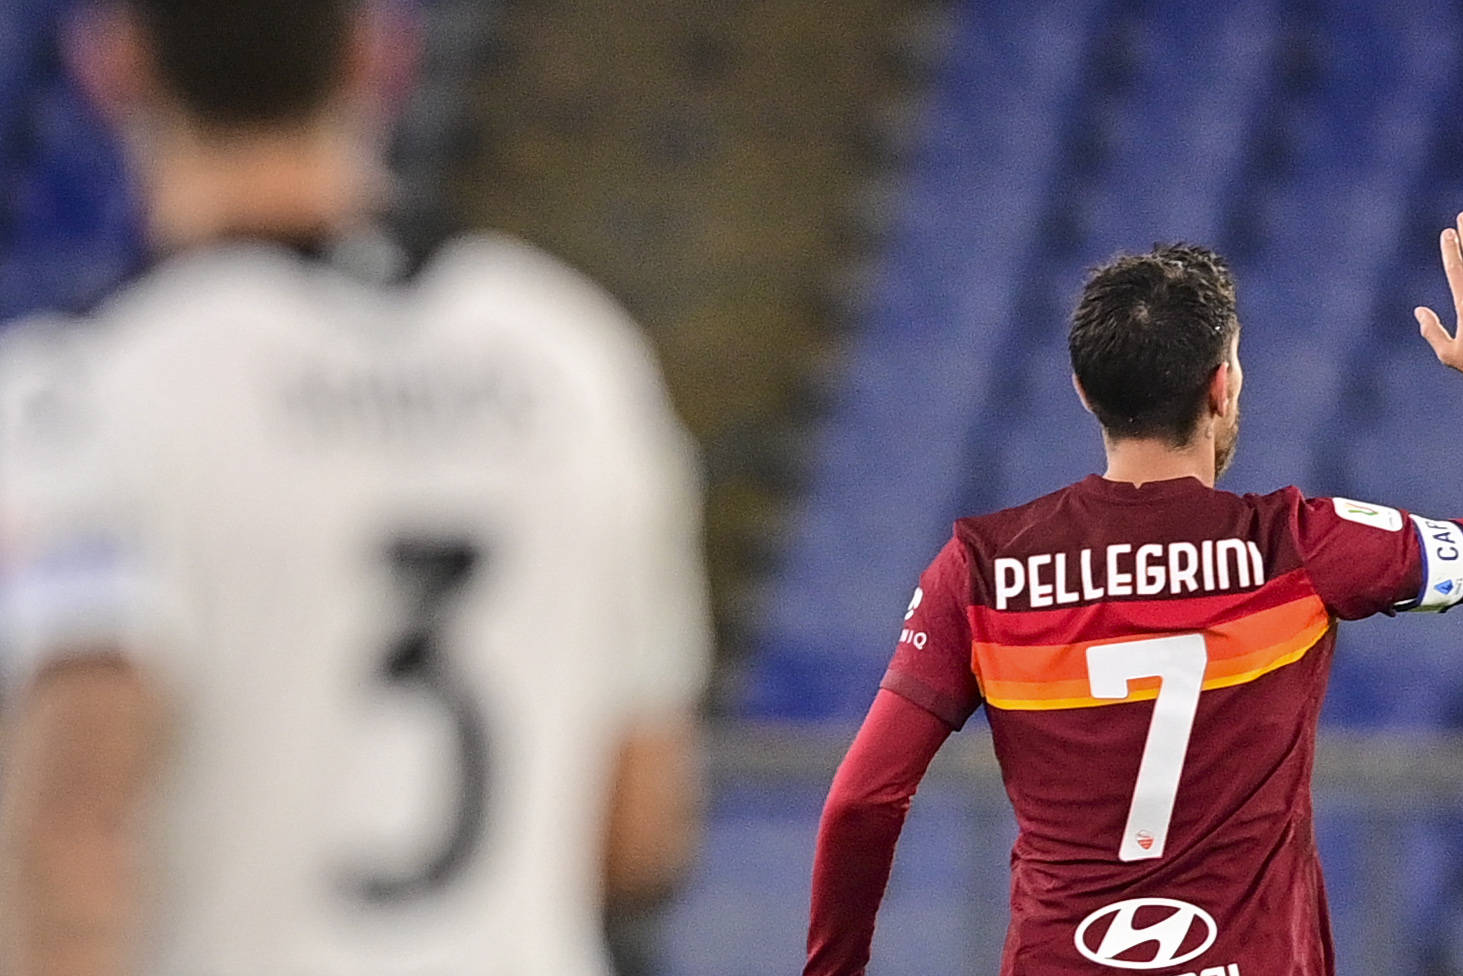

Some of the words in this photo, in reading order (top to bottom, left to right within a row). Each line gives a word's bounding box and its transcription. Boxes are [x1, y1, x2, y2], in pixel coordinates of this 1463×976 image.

[994, 538, 1265, 610] PELLEGRINI
[316, 533, 492, 910] 3
[1086, 633, 1207, 861] 7
